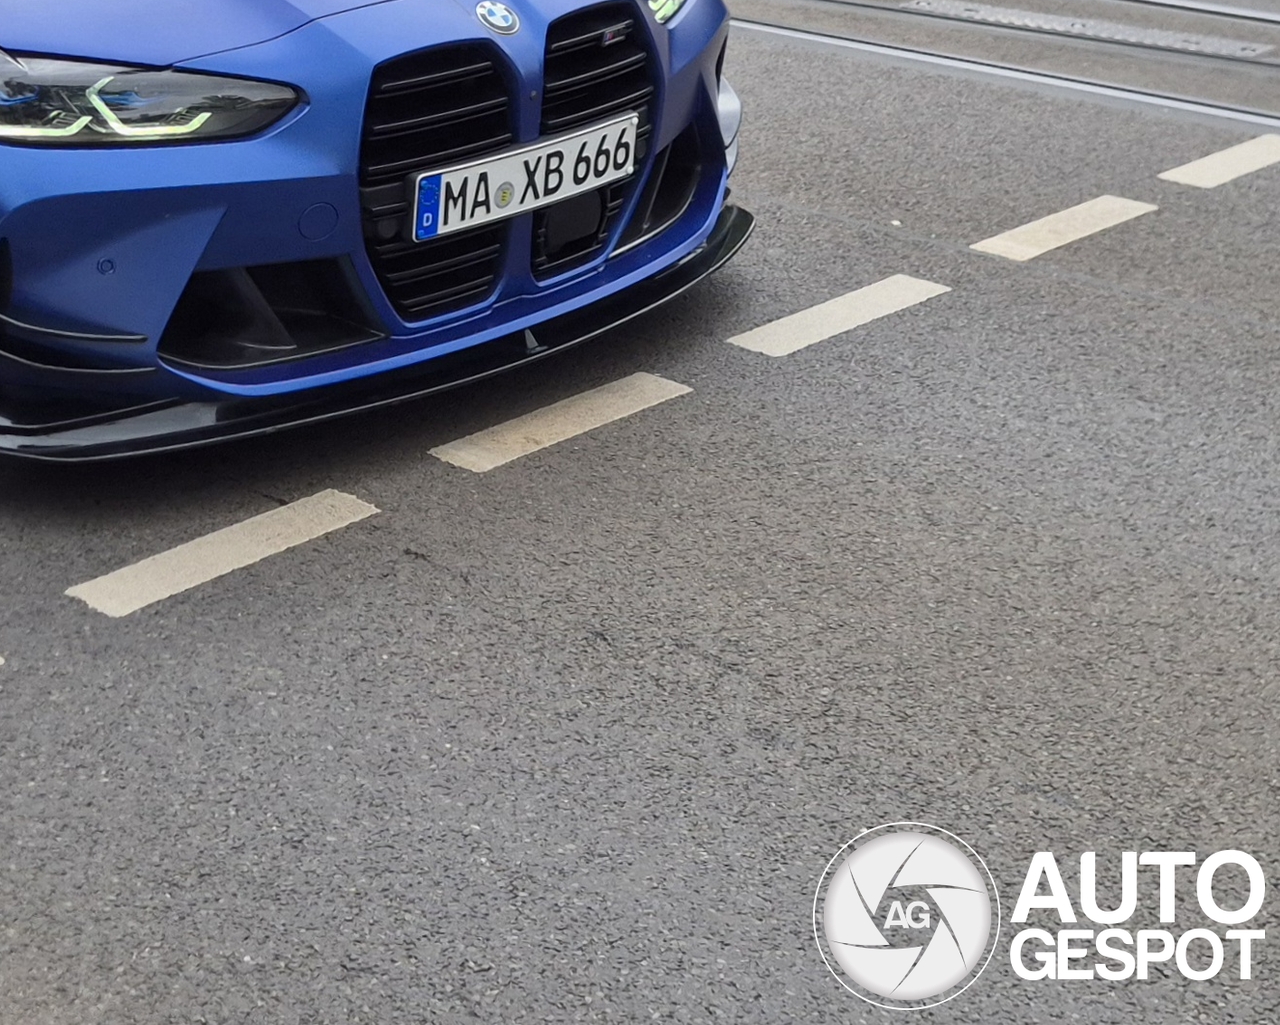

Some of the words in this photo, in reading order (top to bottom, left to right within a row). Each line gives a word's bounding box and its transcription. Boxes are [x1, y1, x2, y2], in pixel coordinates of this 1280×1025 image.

[422, 212, 433, 227] D
[443, 171, 491, 226] MA
[519, 150, 564, 205] XB
[572, 127, 631, 186] 666
